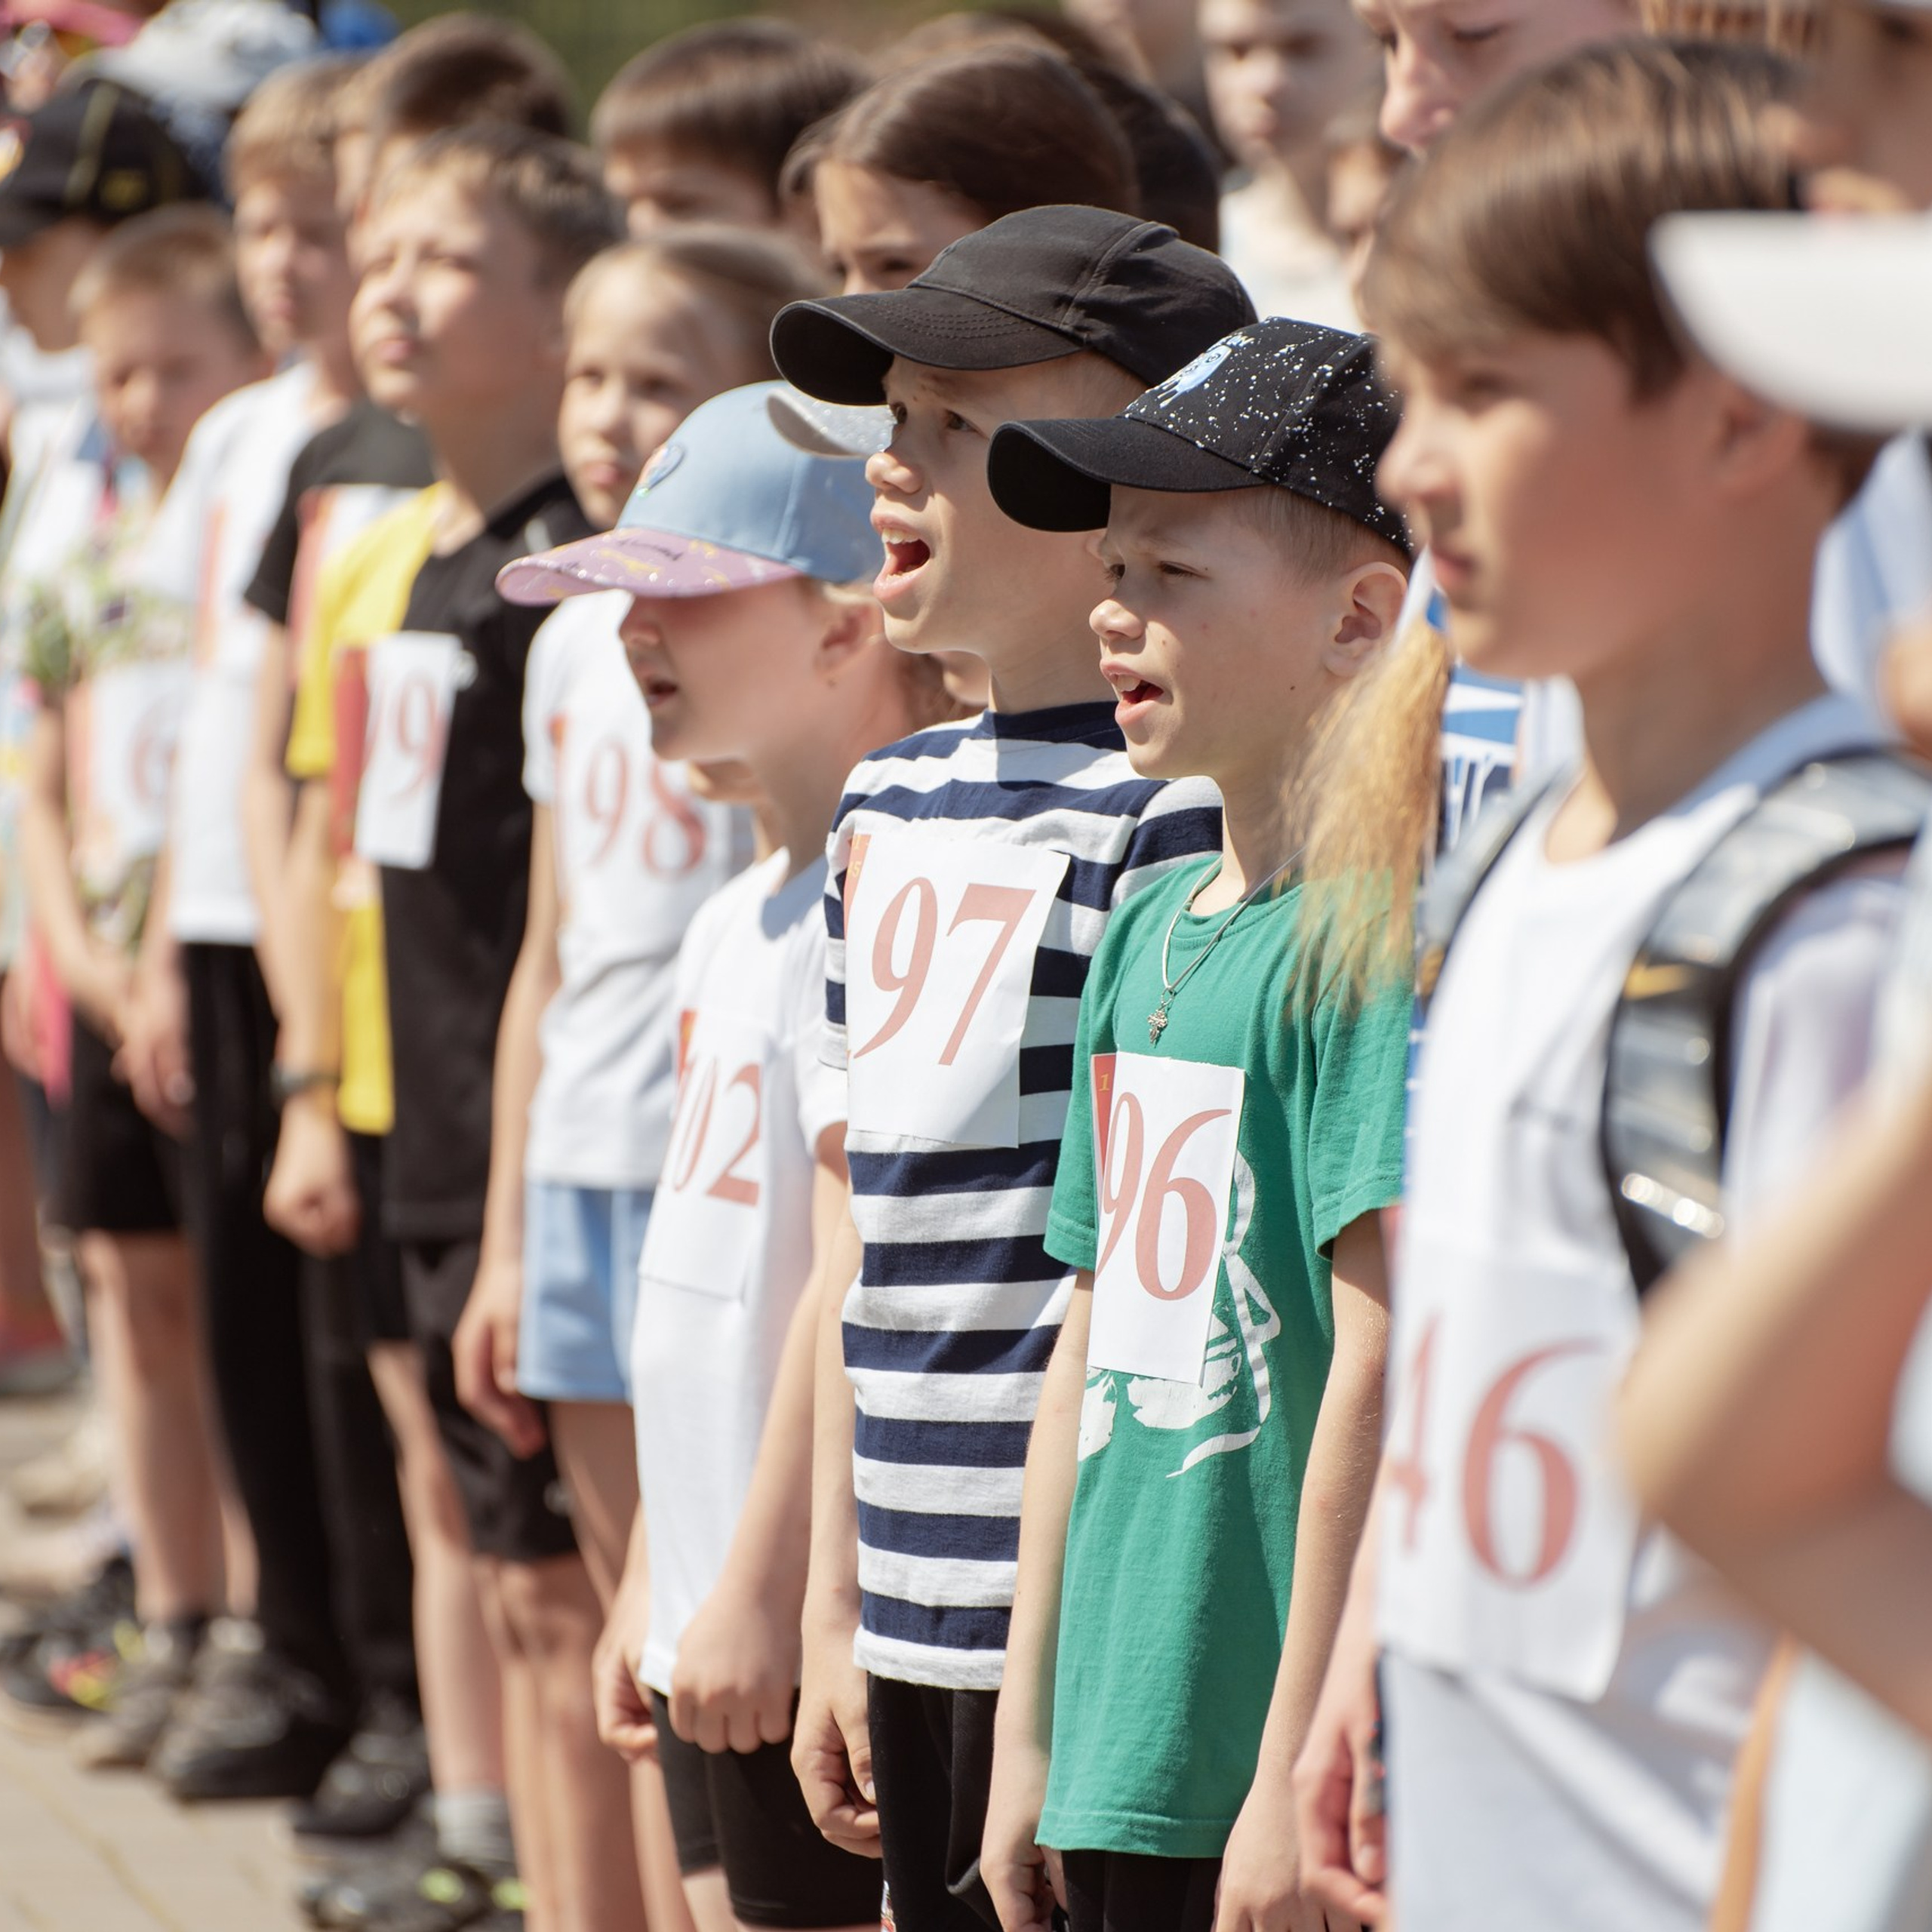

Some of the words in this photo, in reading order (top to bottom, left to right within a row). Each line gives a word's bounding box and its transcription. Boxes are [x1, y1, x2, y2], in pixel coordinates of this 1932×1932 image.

[854, 877, 1036, 1066] 97
[1099, 1073, 1110, 1091] 1
[1094, 1091, 1232, 1300] 96
